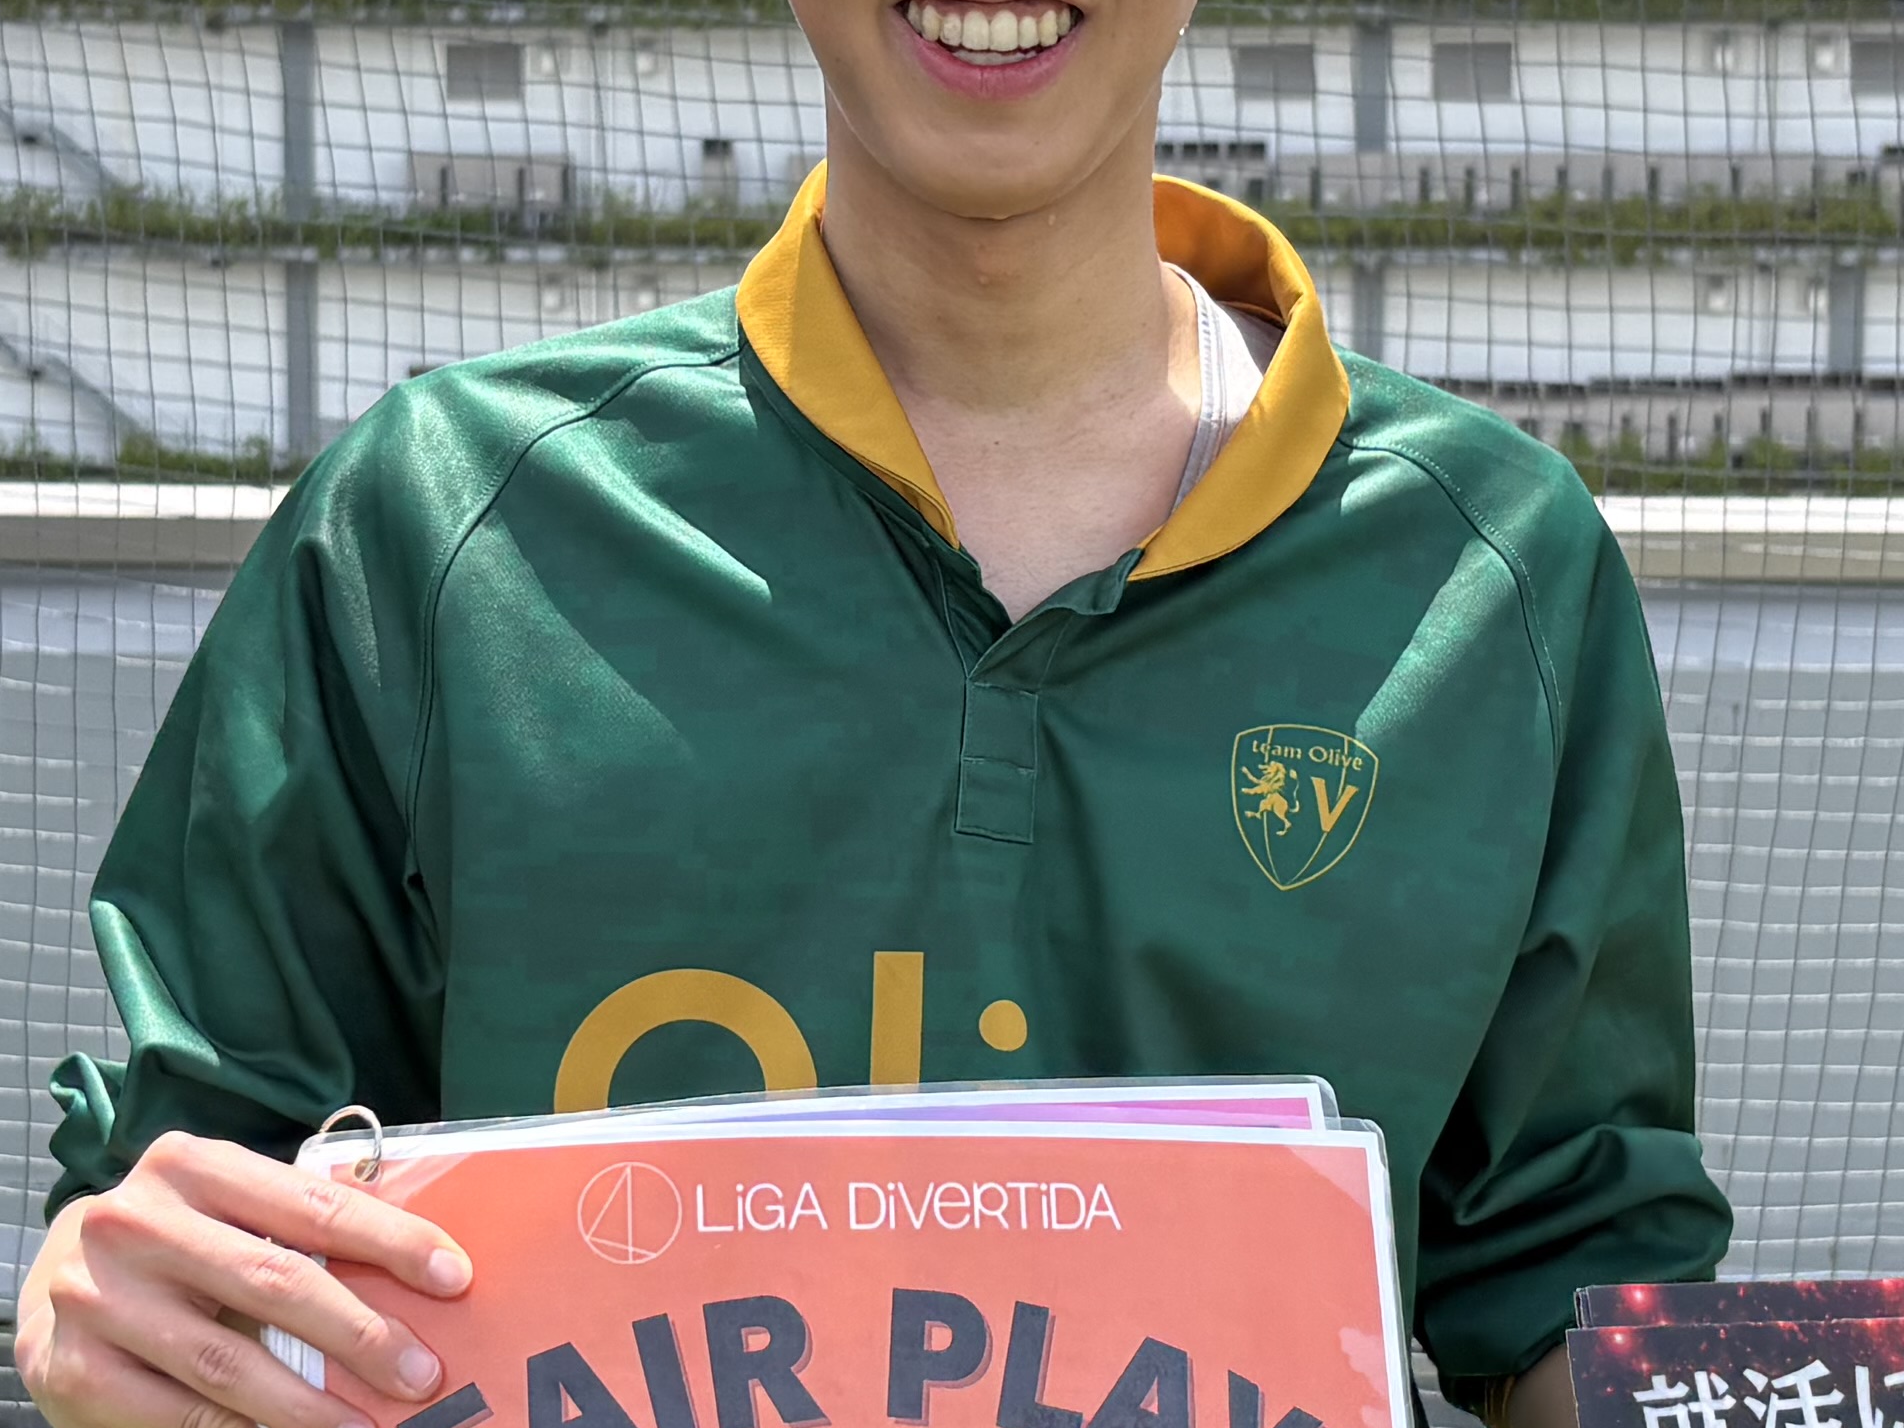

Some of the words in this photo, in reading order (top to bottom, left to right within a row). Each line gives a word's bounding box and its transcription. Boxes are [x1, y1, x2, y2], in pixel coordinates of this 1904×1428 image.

[1308, 745, 1363, 772] Olive
[1310, 775, 1360, 834] V
[553, 950, 1028, 1115] Ol
